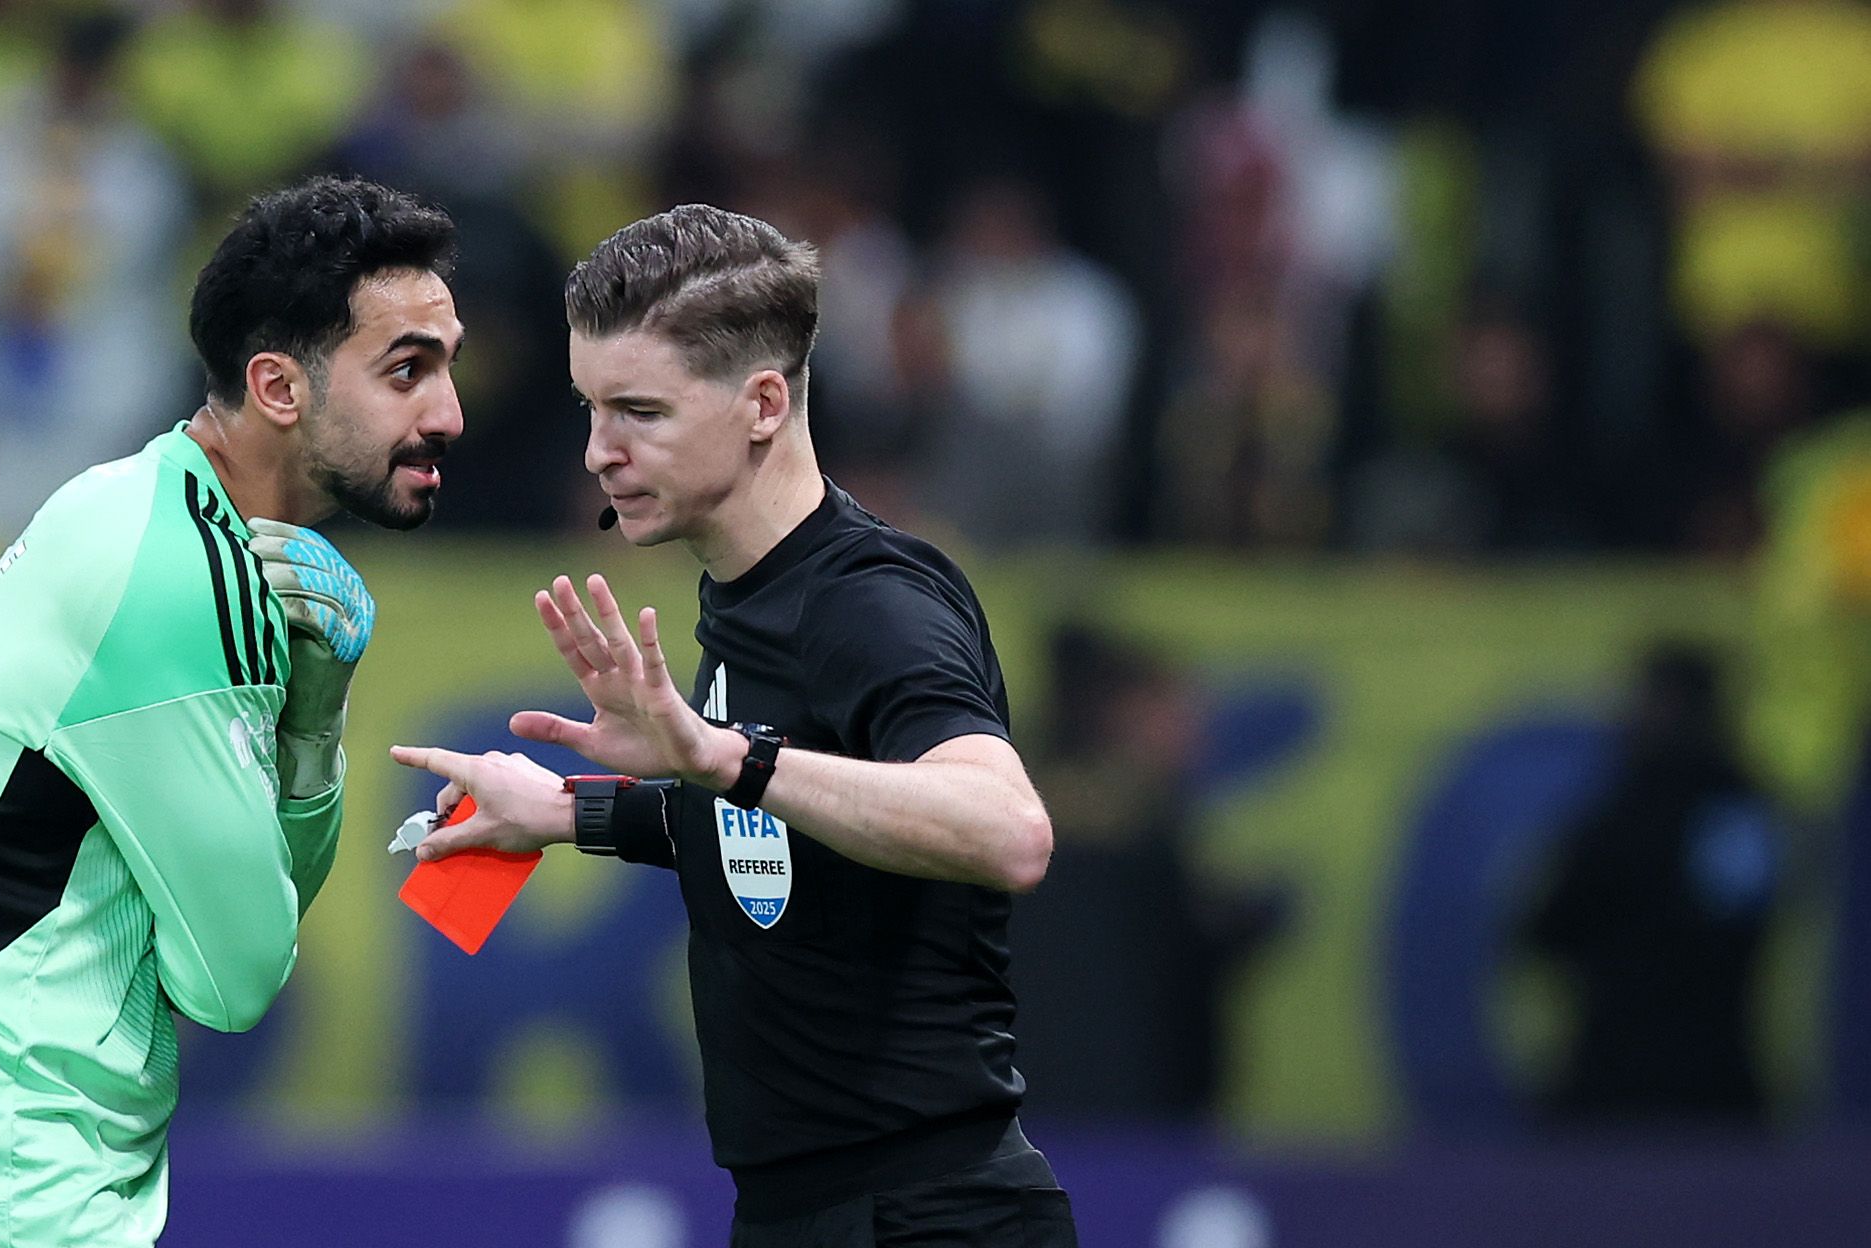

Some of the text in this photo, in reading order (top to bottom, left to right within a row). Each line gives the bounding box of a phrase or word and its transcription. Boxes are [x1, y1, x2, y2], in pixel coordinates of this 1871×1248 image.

[722, 808, 780, 838] FIFA
[729, 858, 786, 876] REFEREE
[750, 901, 776, 916] 2025
